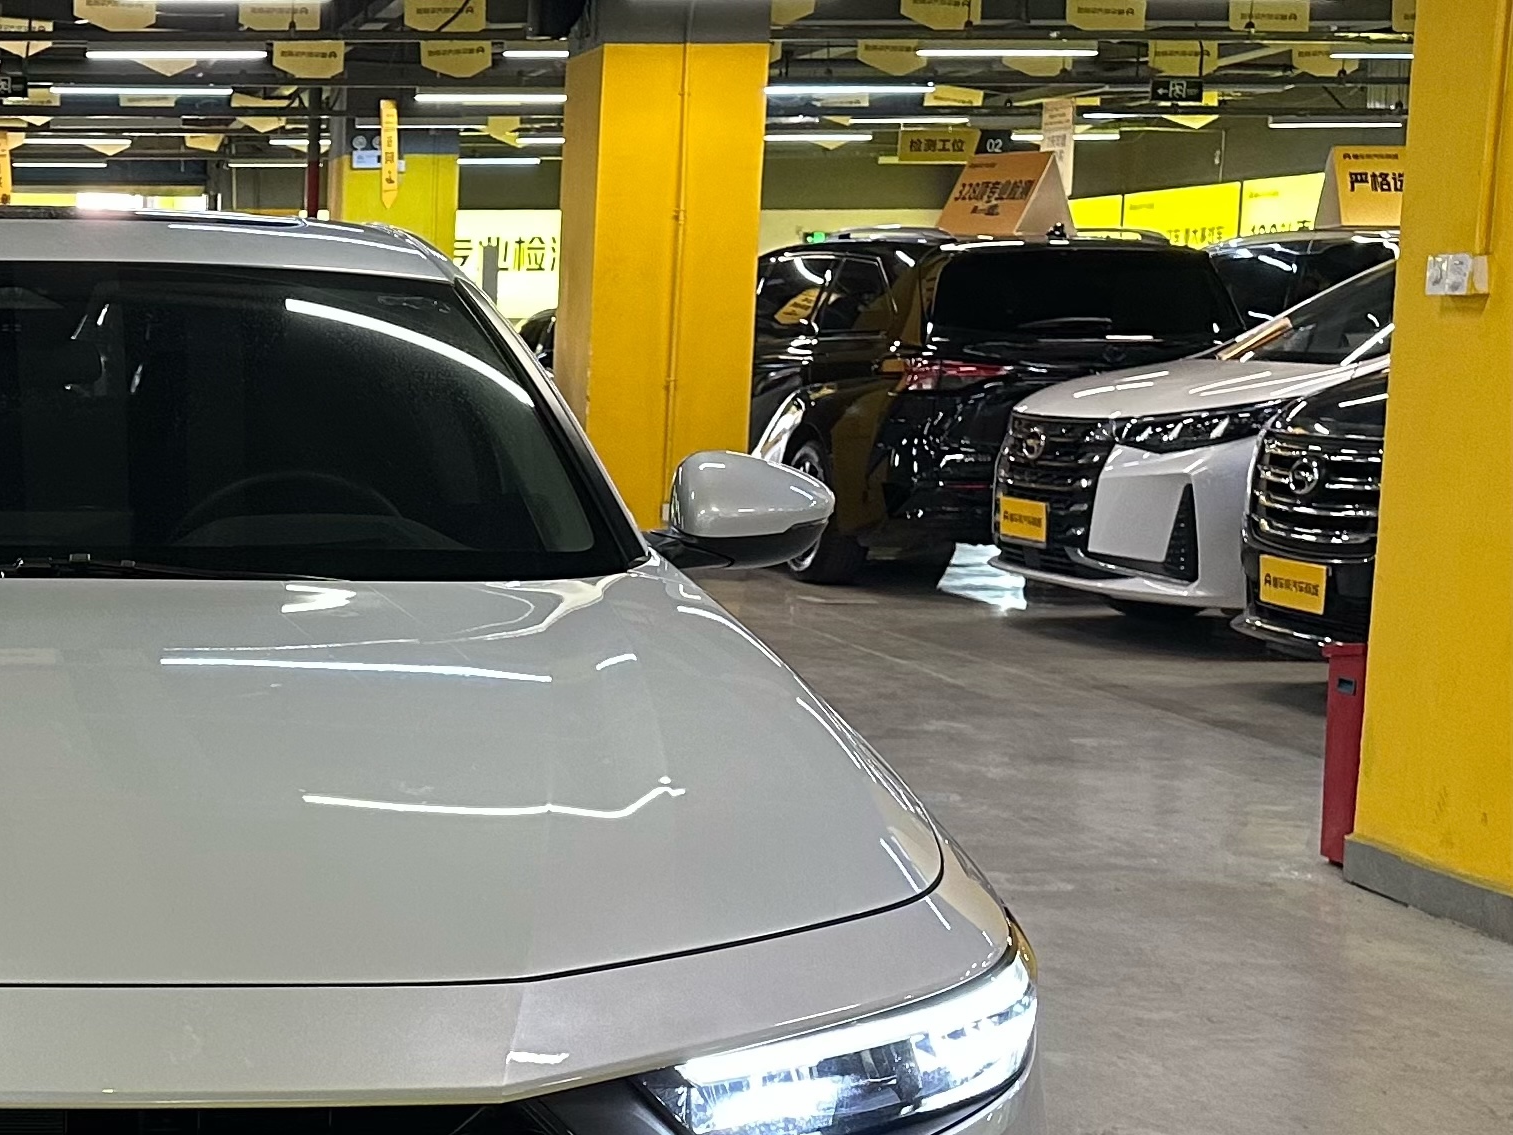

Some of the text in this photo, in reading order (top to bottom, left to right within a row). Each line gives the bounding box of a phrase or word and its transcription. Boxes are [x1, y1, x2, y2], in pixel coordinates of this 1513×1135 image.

[909, 138, 966, 153] 检测工位
[986, 138, 1003, 153] 02
